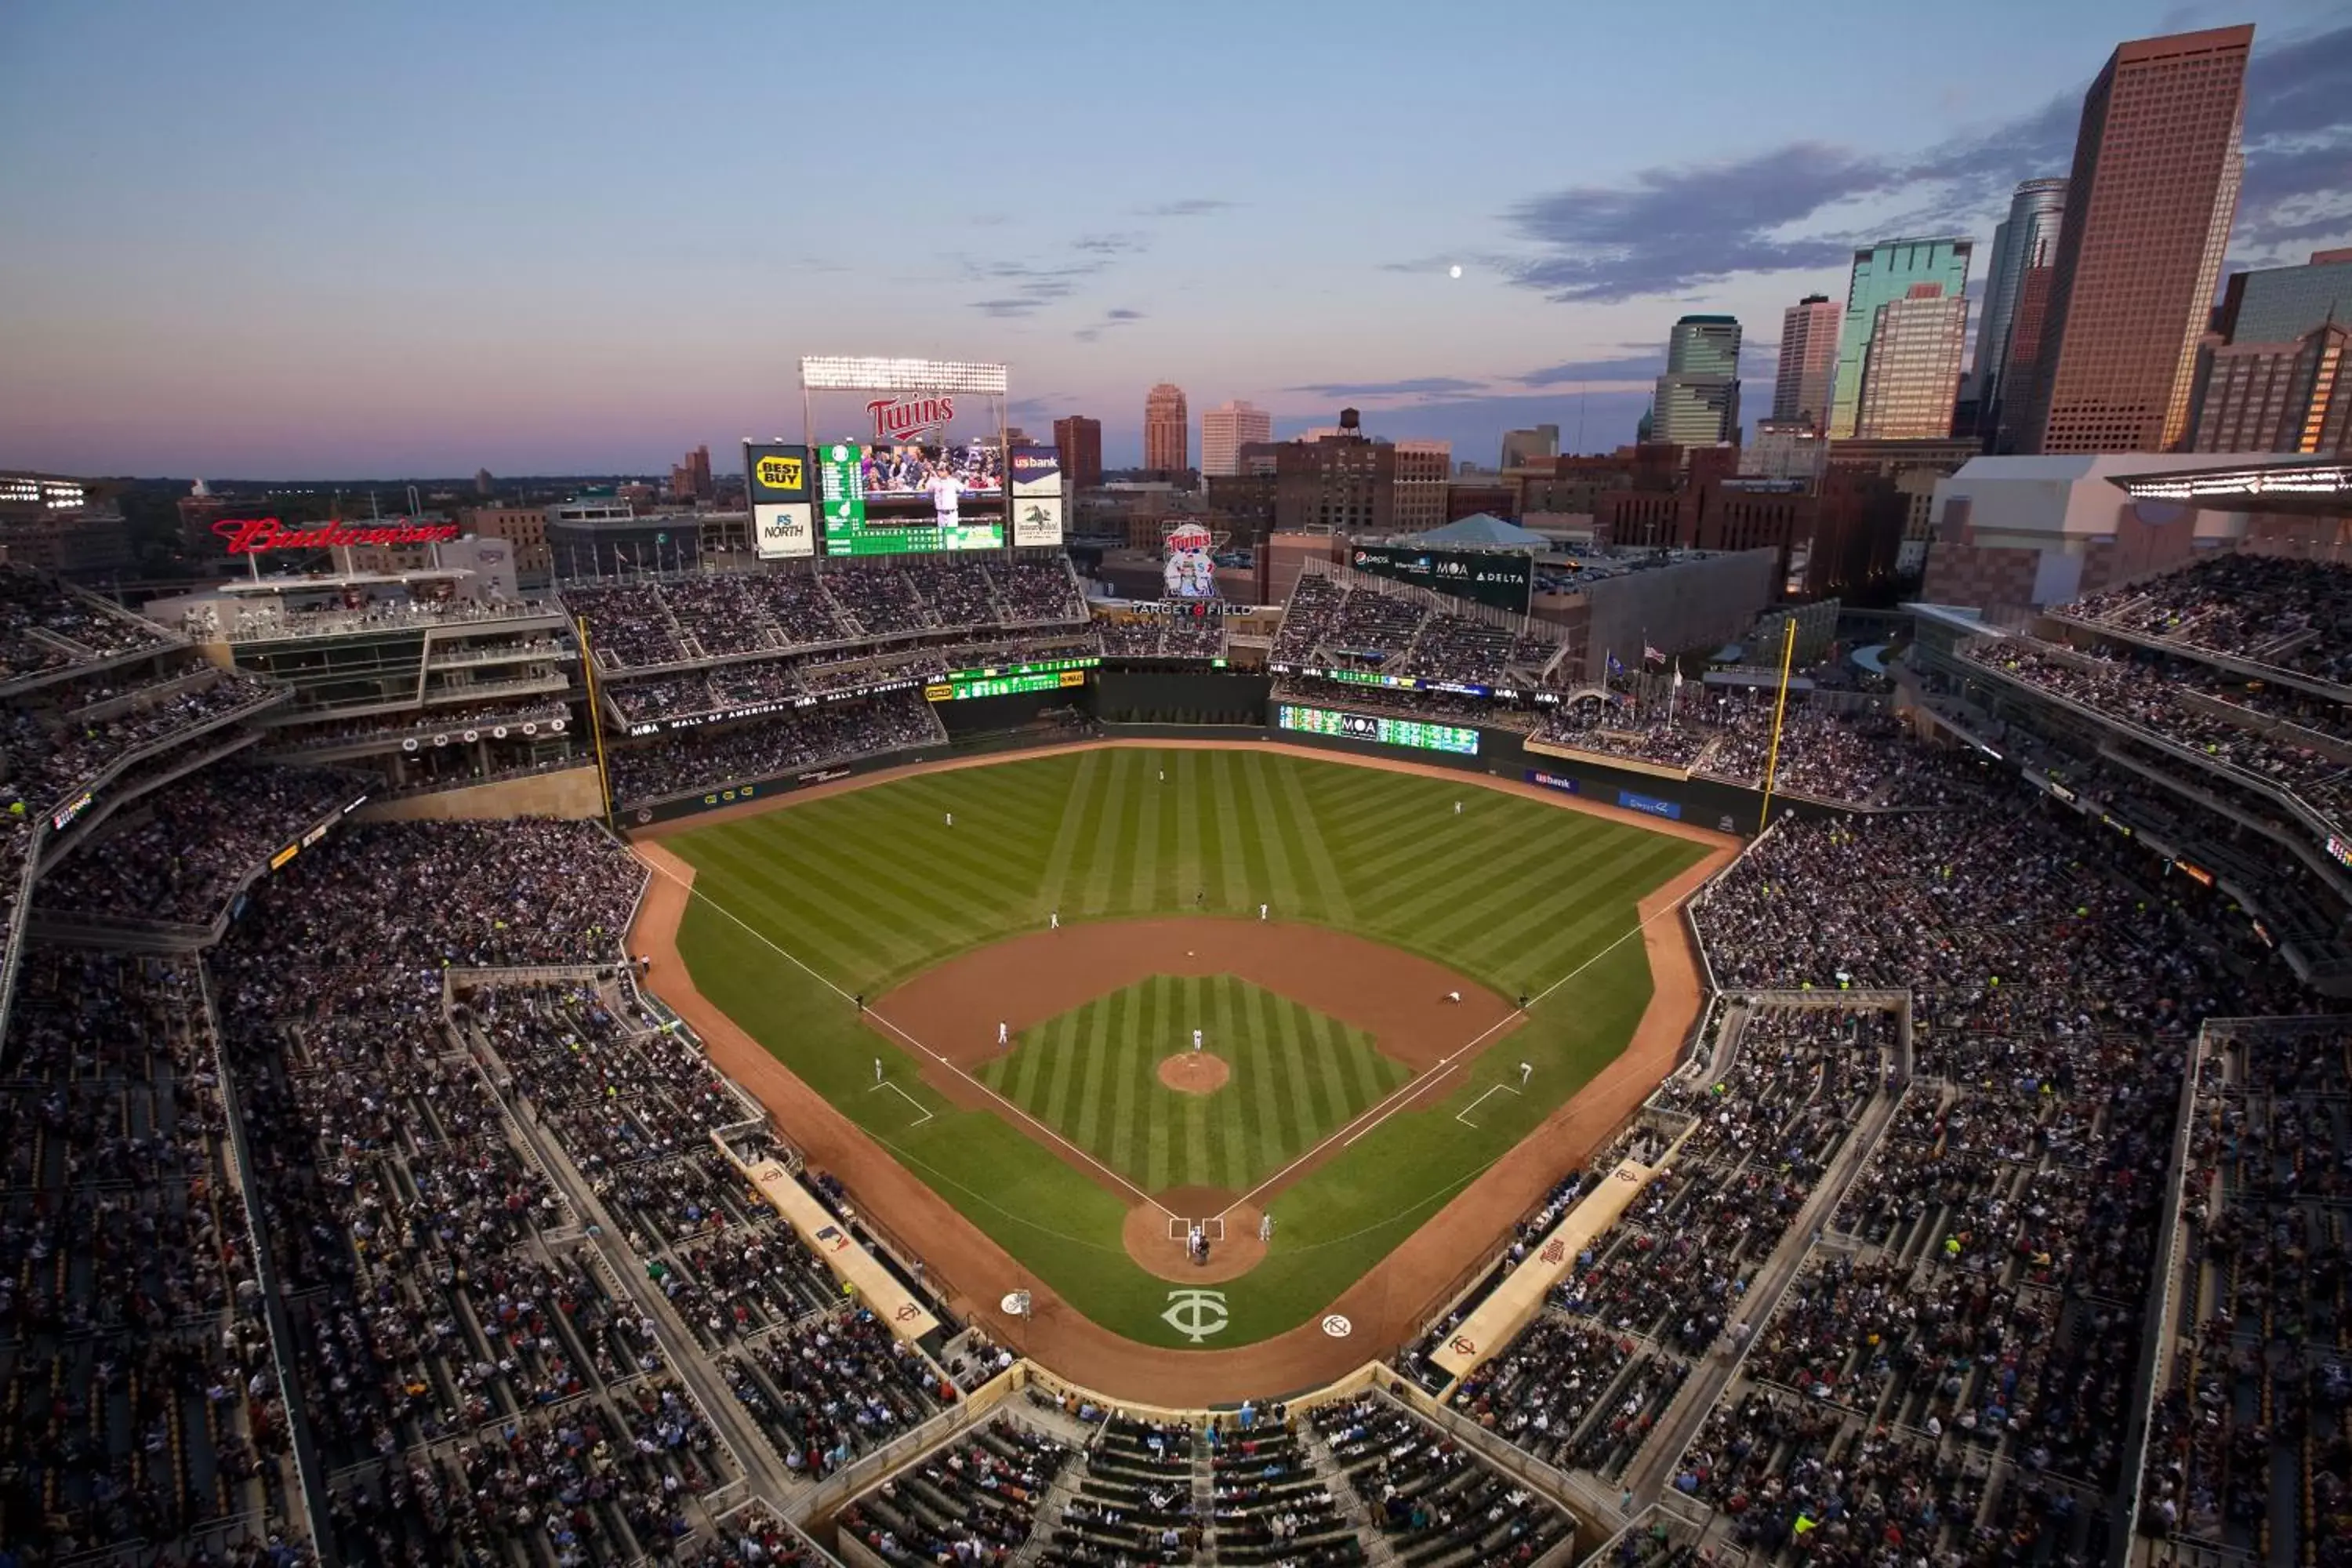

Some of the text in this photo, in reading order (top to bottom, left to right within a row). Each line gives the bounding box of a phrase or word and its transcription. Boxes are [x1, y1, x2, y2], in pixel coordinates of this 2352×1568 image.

[866, 392, 953, 438] Twins
[762, 463, 800, 474] BEST
[764, 473, 797, 485] BUY
[211, 517, 459, 554] Budweiser
[764, 525, 804, 538] NORTH
[1167, 533, 1211, 554] Twins
[1487, 573, 1523, 584] DELTA
[1132, 604, 1252, 615] TARGET FIELD
[827, 692, 852, 701] MALL
[671, 717, 703, 728] MALL
[708, 713, 722, 722] OF
[1341, 717, 1376, 734] MOA
